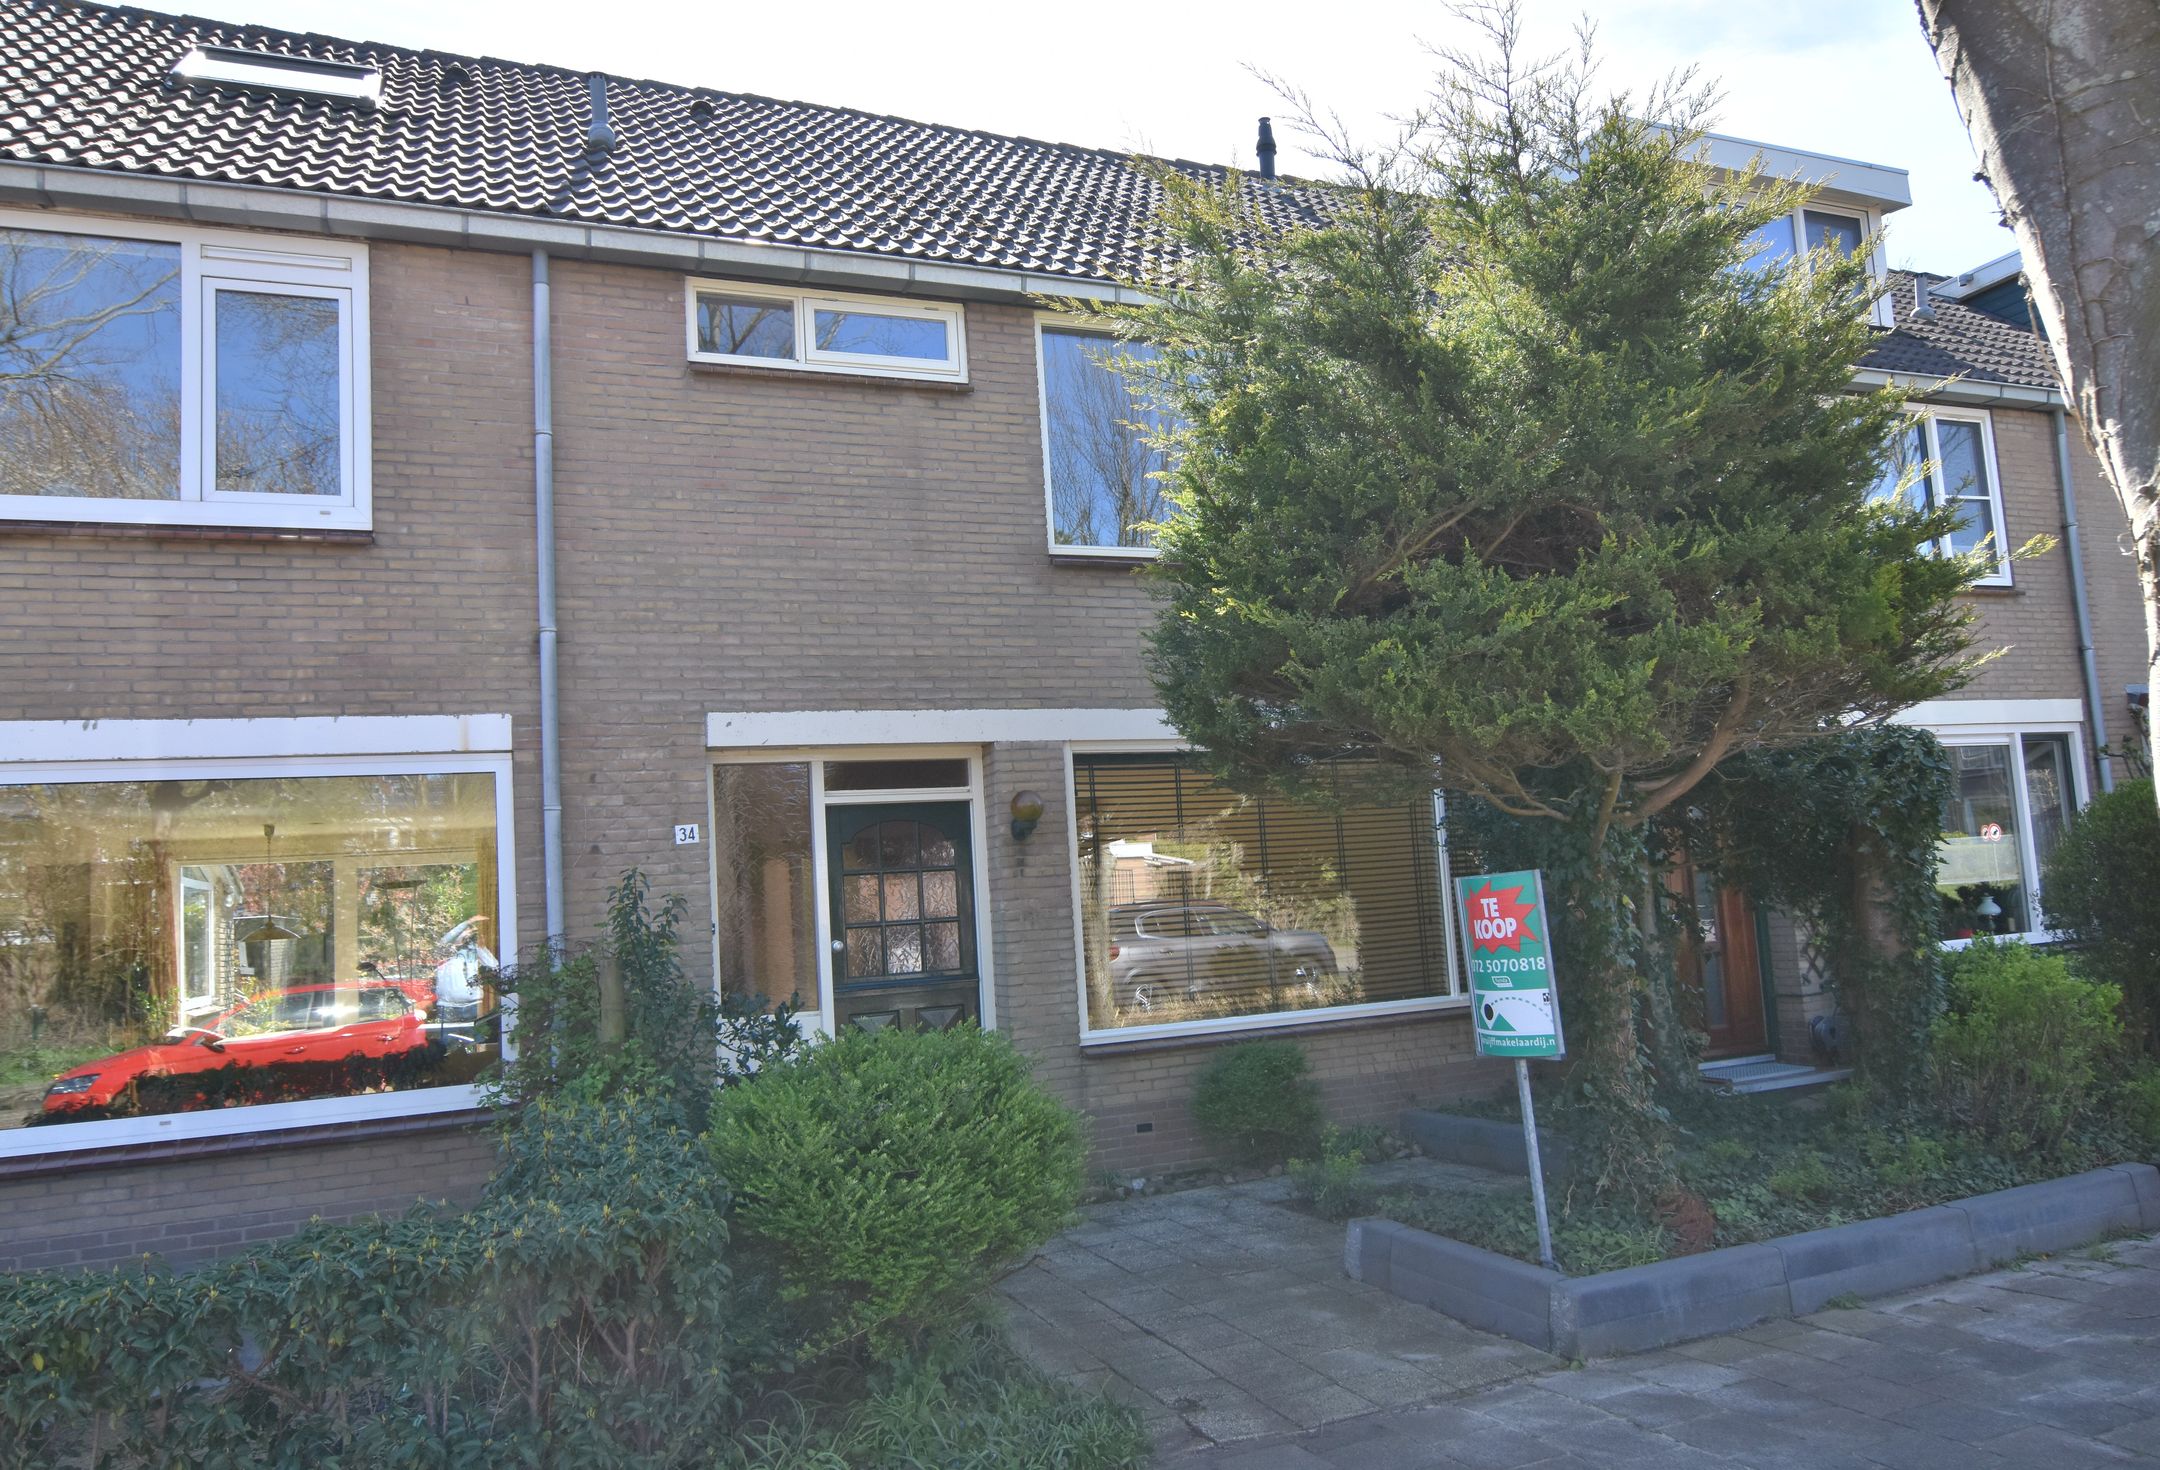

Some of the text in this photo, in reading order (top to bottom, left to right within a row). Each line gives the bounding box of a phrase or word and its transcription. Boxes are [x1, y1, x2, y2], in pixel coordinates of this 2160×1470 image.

[679, 826, 695, 841] 34
[1480, 897, 1500, 918] TE
[1473, 917, 1517, 940] KOOP
[1486, 956, 1546, 973] 5070818
